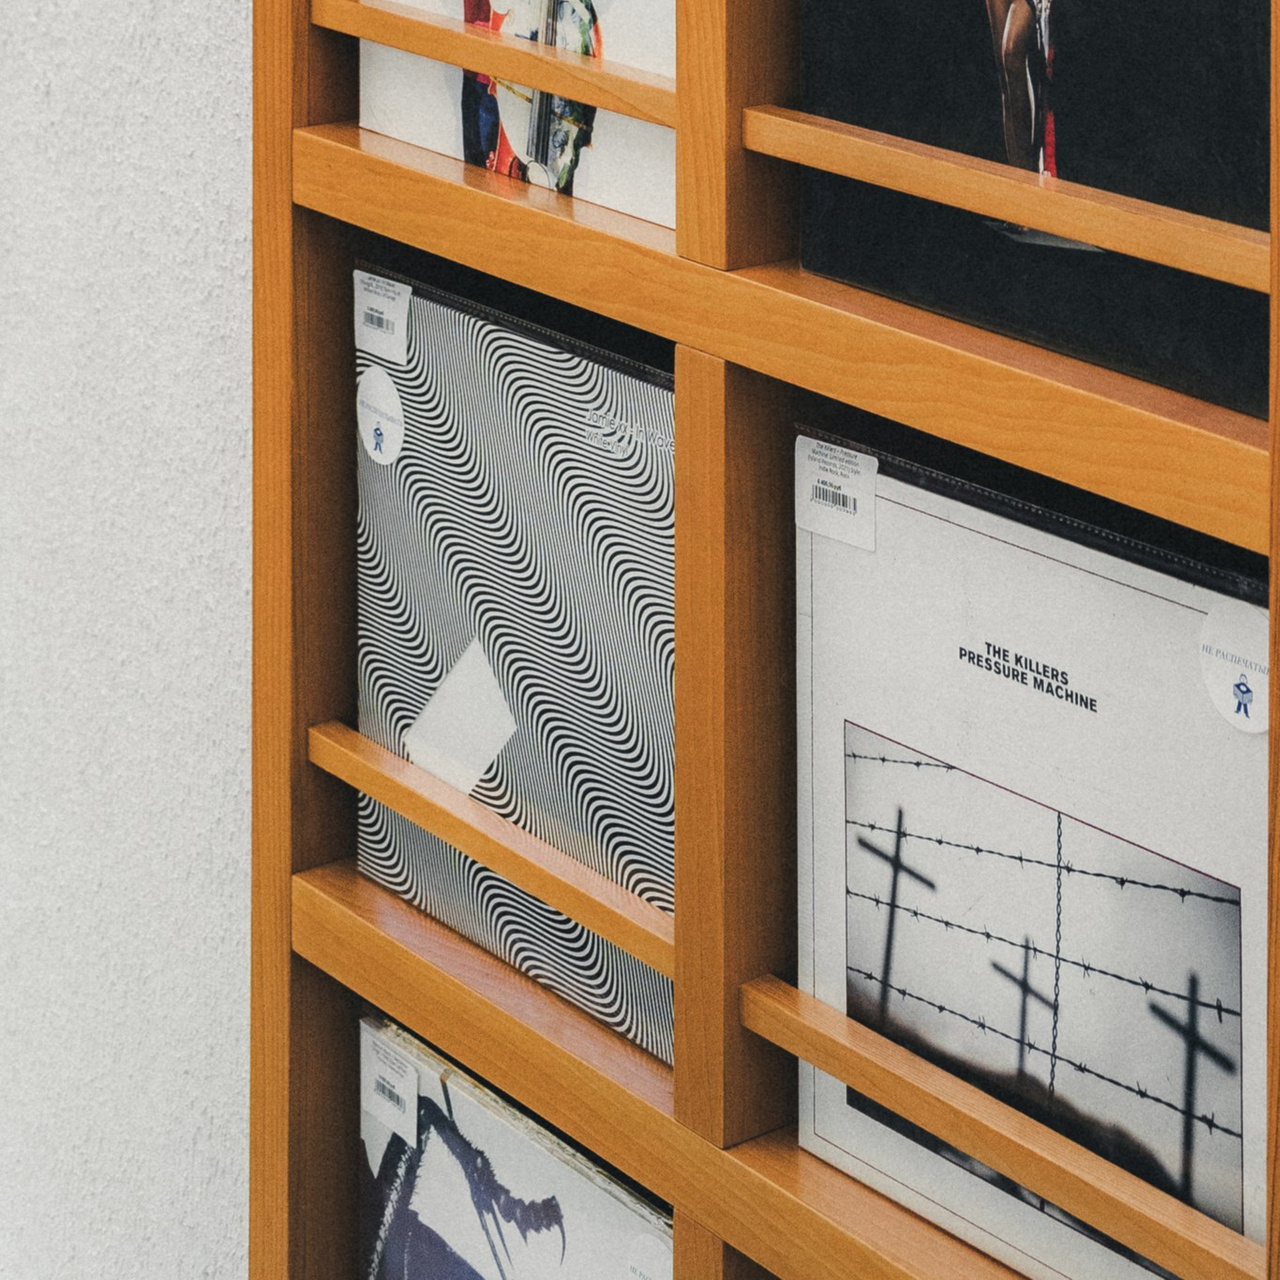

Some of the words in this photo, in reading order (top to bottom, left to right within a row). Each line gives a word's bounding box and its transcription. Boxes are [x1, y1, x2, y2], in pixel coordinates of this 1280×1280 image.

[586, 408, 616, 430] Jamie
[984, 641, 1010, 663] THE
[1014, 653, 1069, 686] KILLERS
[1202, 644, 1213, 655] НЕ
[958, 646, 1029, 686] PRESSURE
[1033, 674, 1098, 714] MACHINE
